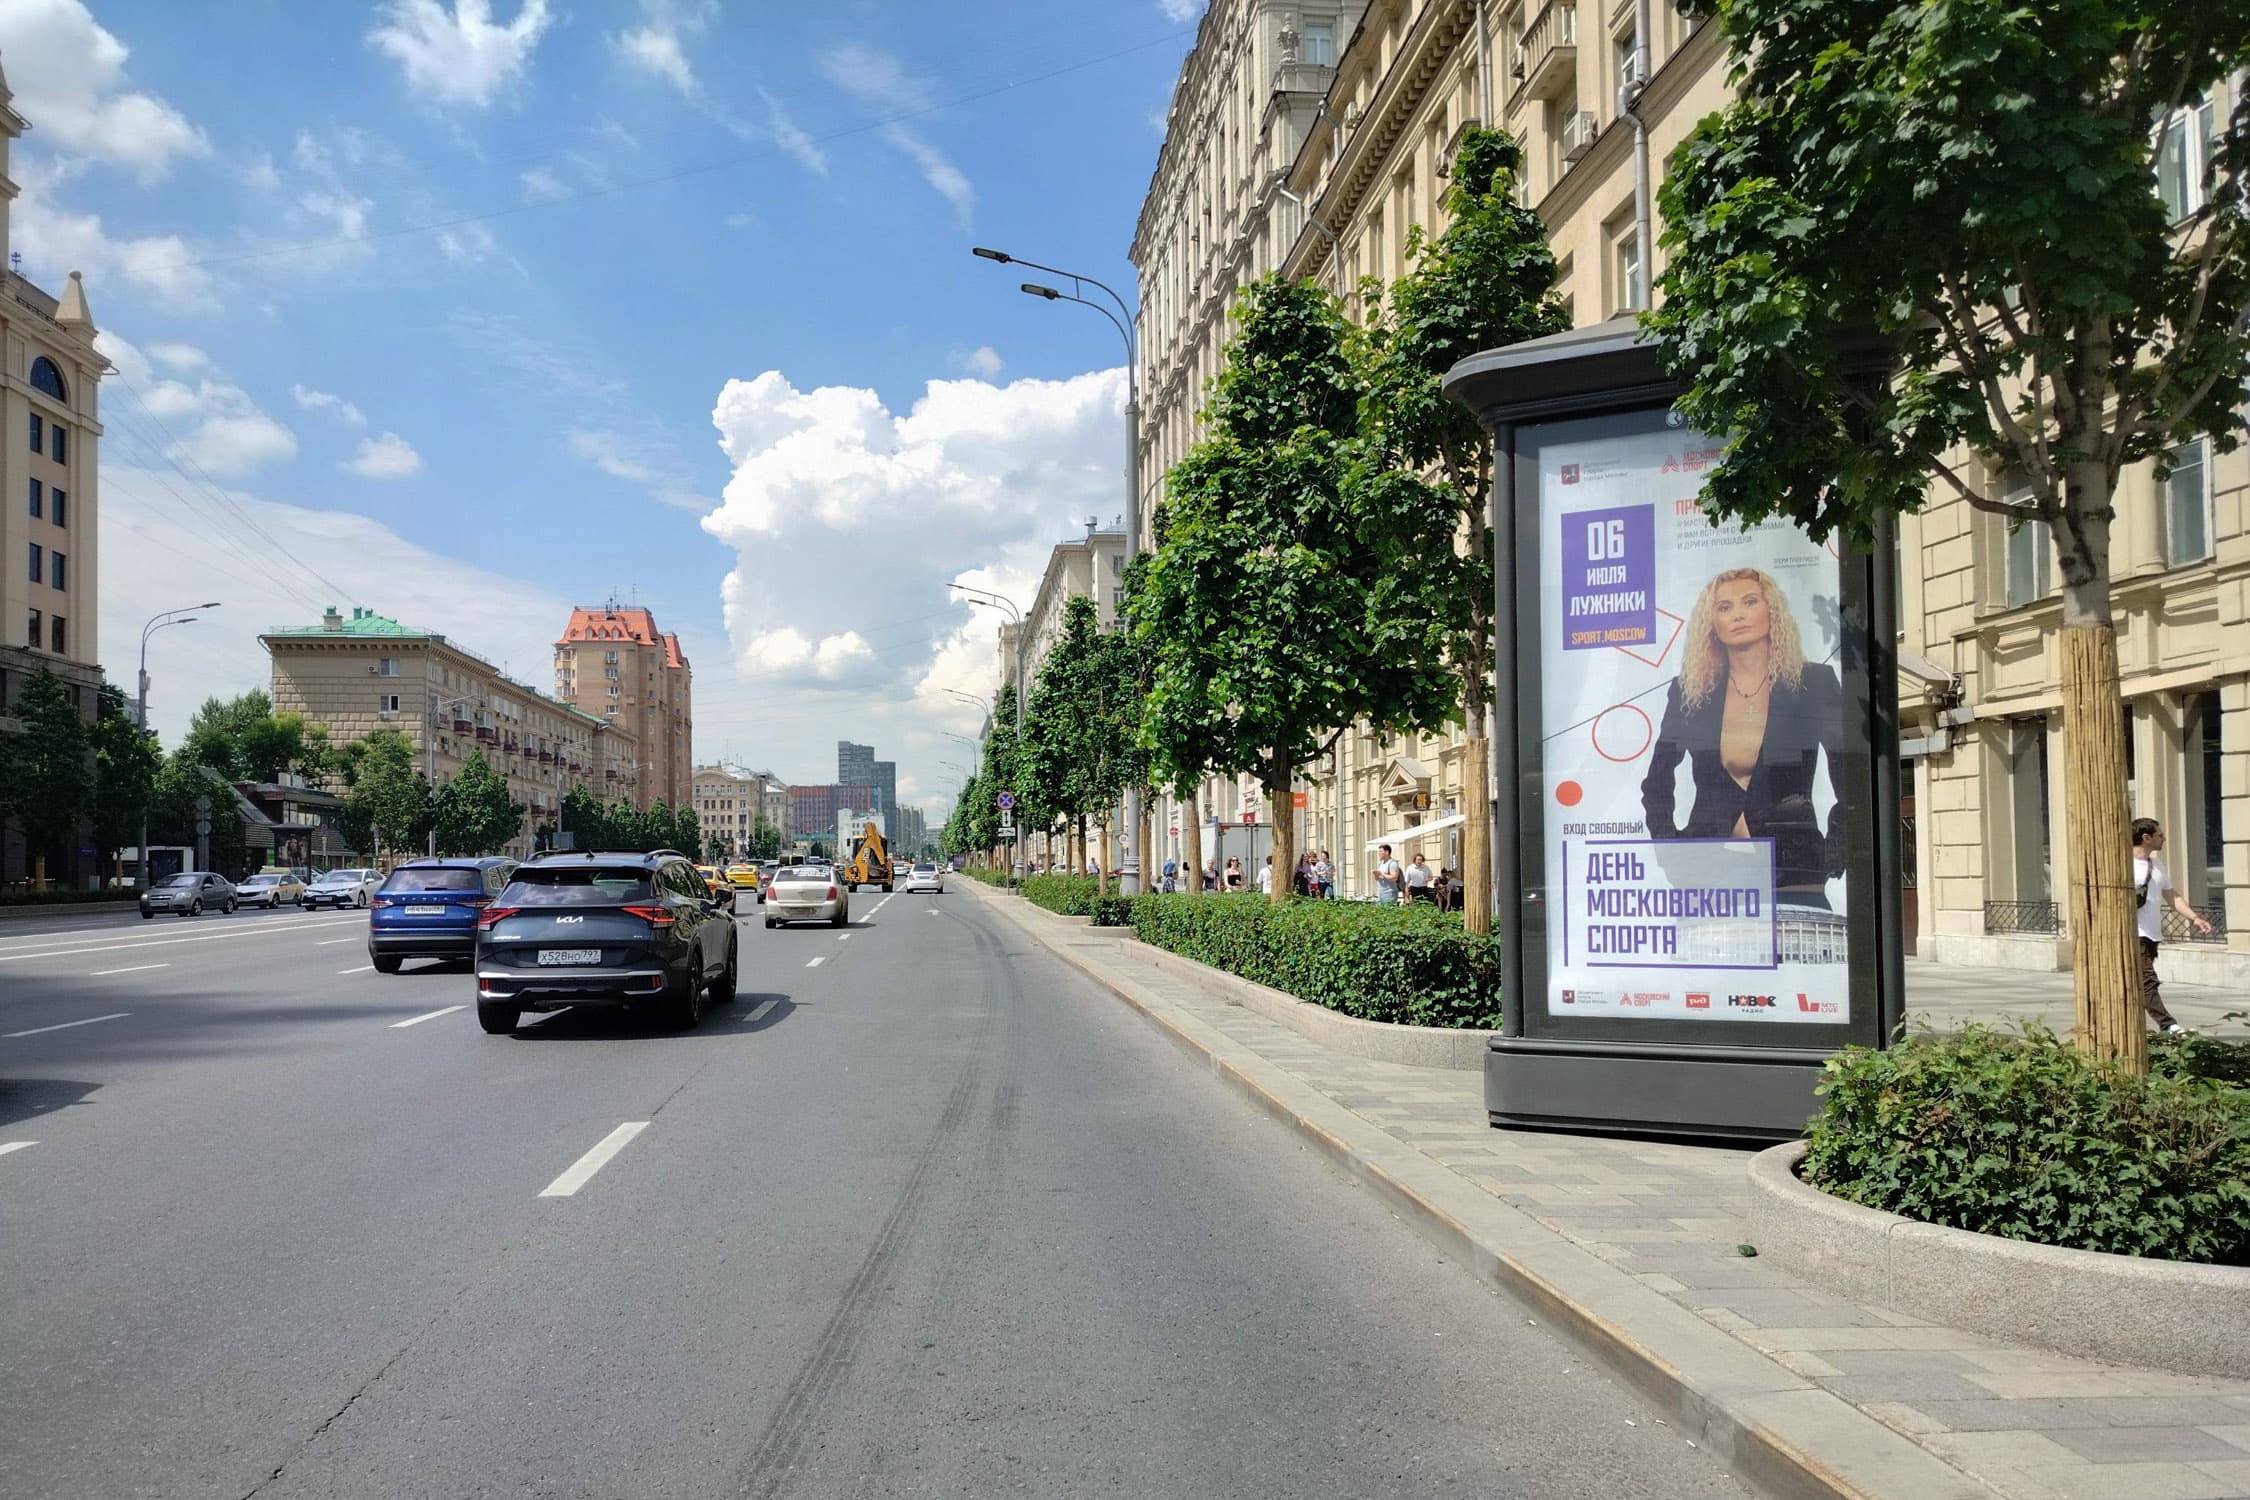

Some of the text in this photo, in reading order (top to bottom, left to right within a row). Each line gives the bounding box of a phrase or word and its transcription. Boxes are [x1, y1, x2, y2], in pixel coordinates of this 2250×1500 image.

[1588, 520, 1624, 560] 06
[1711, 535, 1752, 547] ПЛОЩАДКИ
[1586, 565, 1627, 587] ИЮЛЯ
[1570, 590, 1646, 617] ЛУЖНИКИ
[1571, 626, 1647, 645] SPORT.MOSCOW
[1563, 821, 1644, 836] ВХОД СВОБОДНЫЙ
[1586, 852, 1645, 884] ДЕНЬ
[1587, 888, 1761, 918] МОСКОВСКОГО
[1587, 925, 1677, 954] СПОРТА
